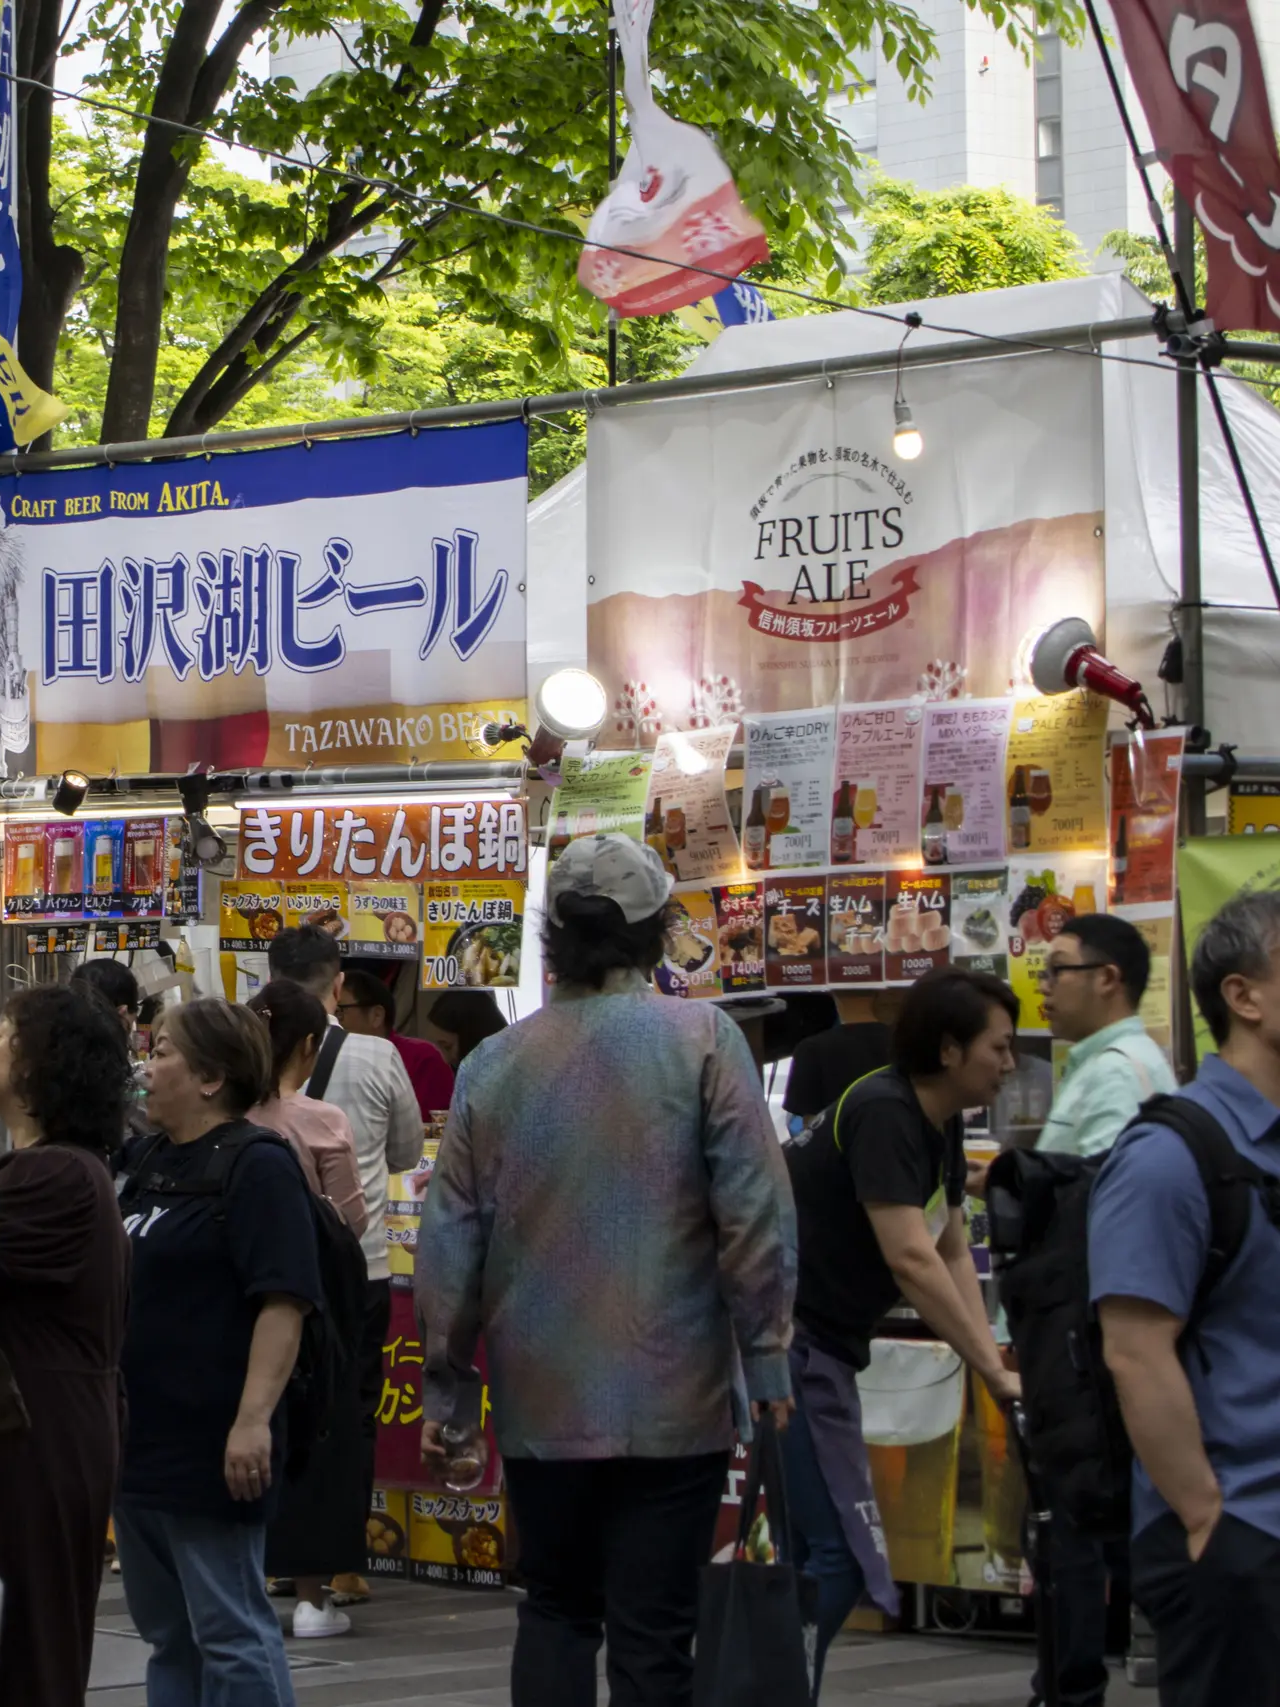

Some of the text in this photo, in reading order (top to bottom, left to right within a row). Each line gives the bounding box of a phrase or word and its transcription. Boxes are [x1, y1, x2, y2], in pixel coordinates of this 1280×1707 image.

[754, 507, 904, 560] FRUITS
[787, 560, 871, 605] ALE
[42, 528, 508, 686] 田沢湖ビール
[758, 602, 900, 638] 信州須坂フルーツエール
[285, 714, 434, 753] TAZAWAKO
[243, 802, 527, 878] きりたんぽ鍋
[132, 896, 155, 909] アルト
[222, 894, 281, 909] ミックスナッツ
[286, 894, 341, 910] いぶりがっこ
[777, 897, 821, 917] チーズ
[830, 895, 873, 915] 生ハム
[898, 890, 946, 911] 生ハム
[428, 901, 512, 921] きりたんぽ鍋
[845, 925, 885, 944] チーズ
[670, 970, 715, 988] 650円
[413, 1494, 501, 1521] ミックスナッツ
